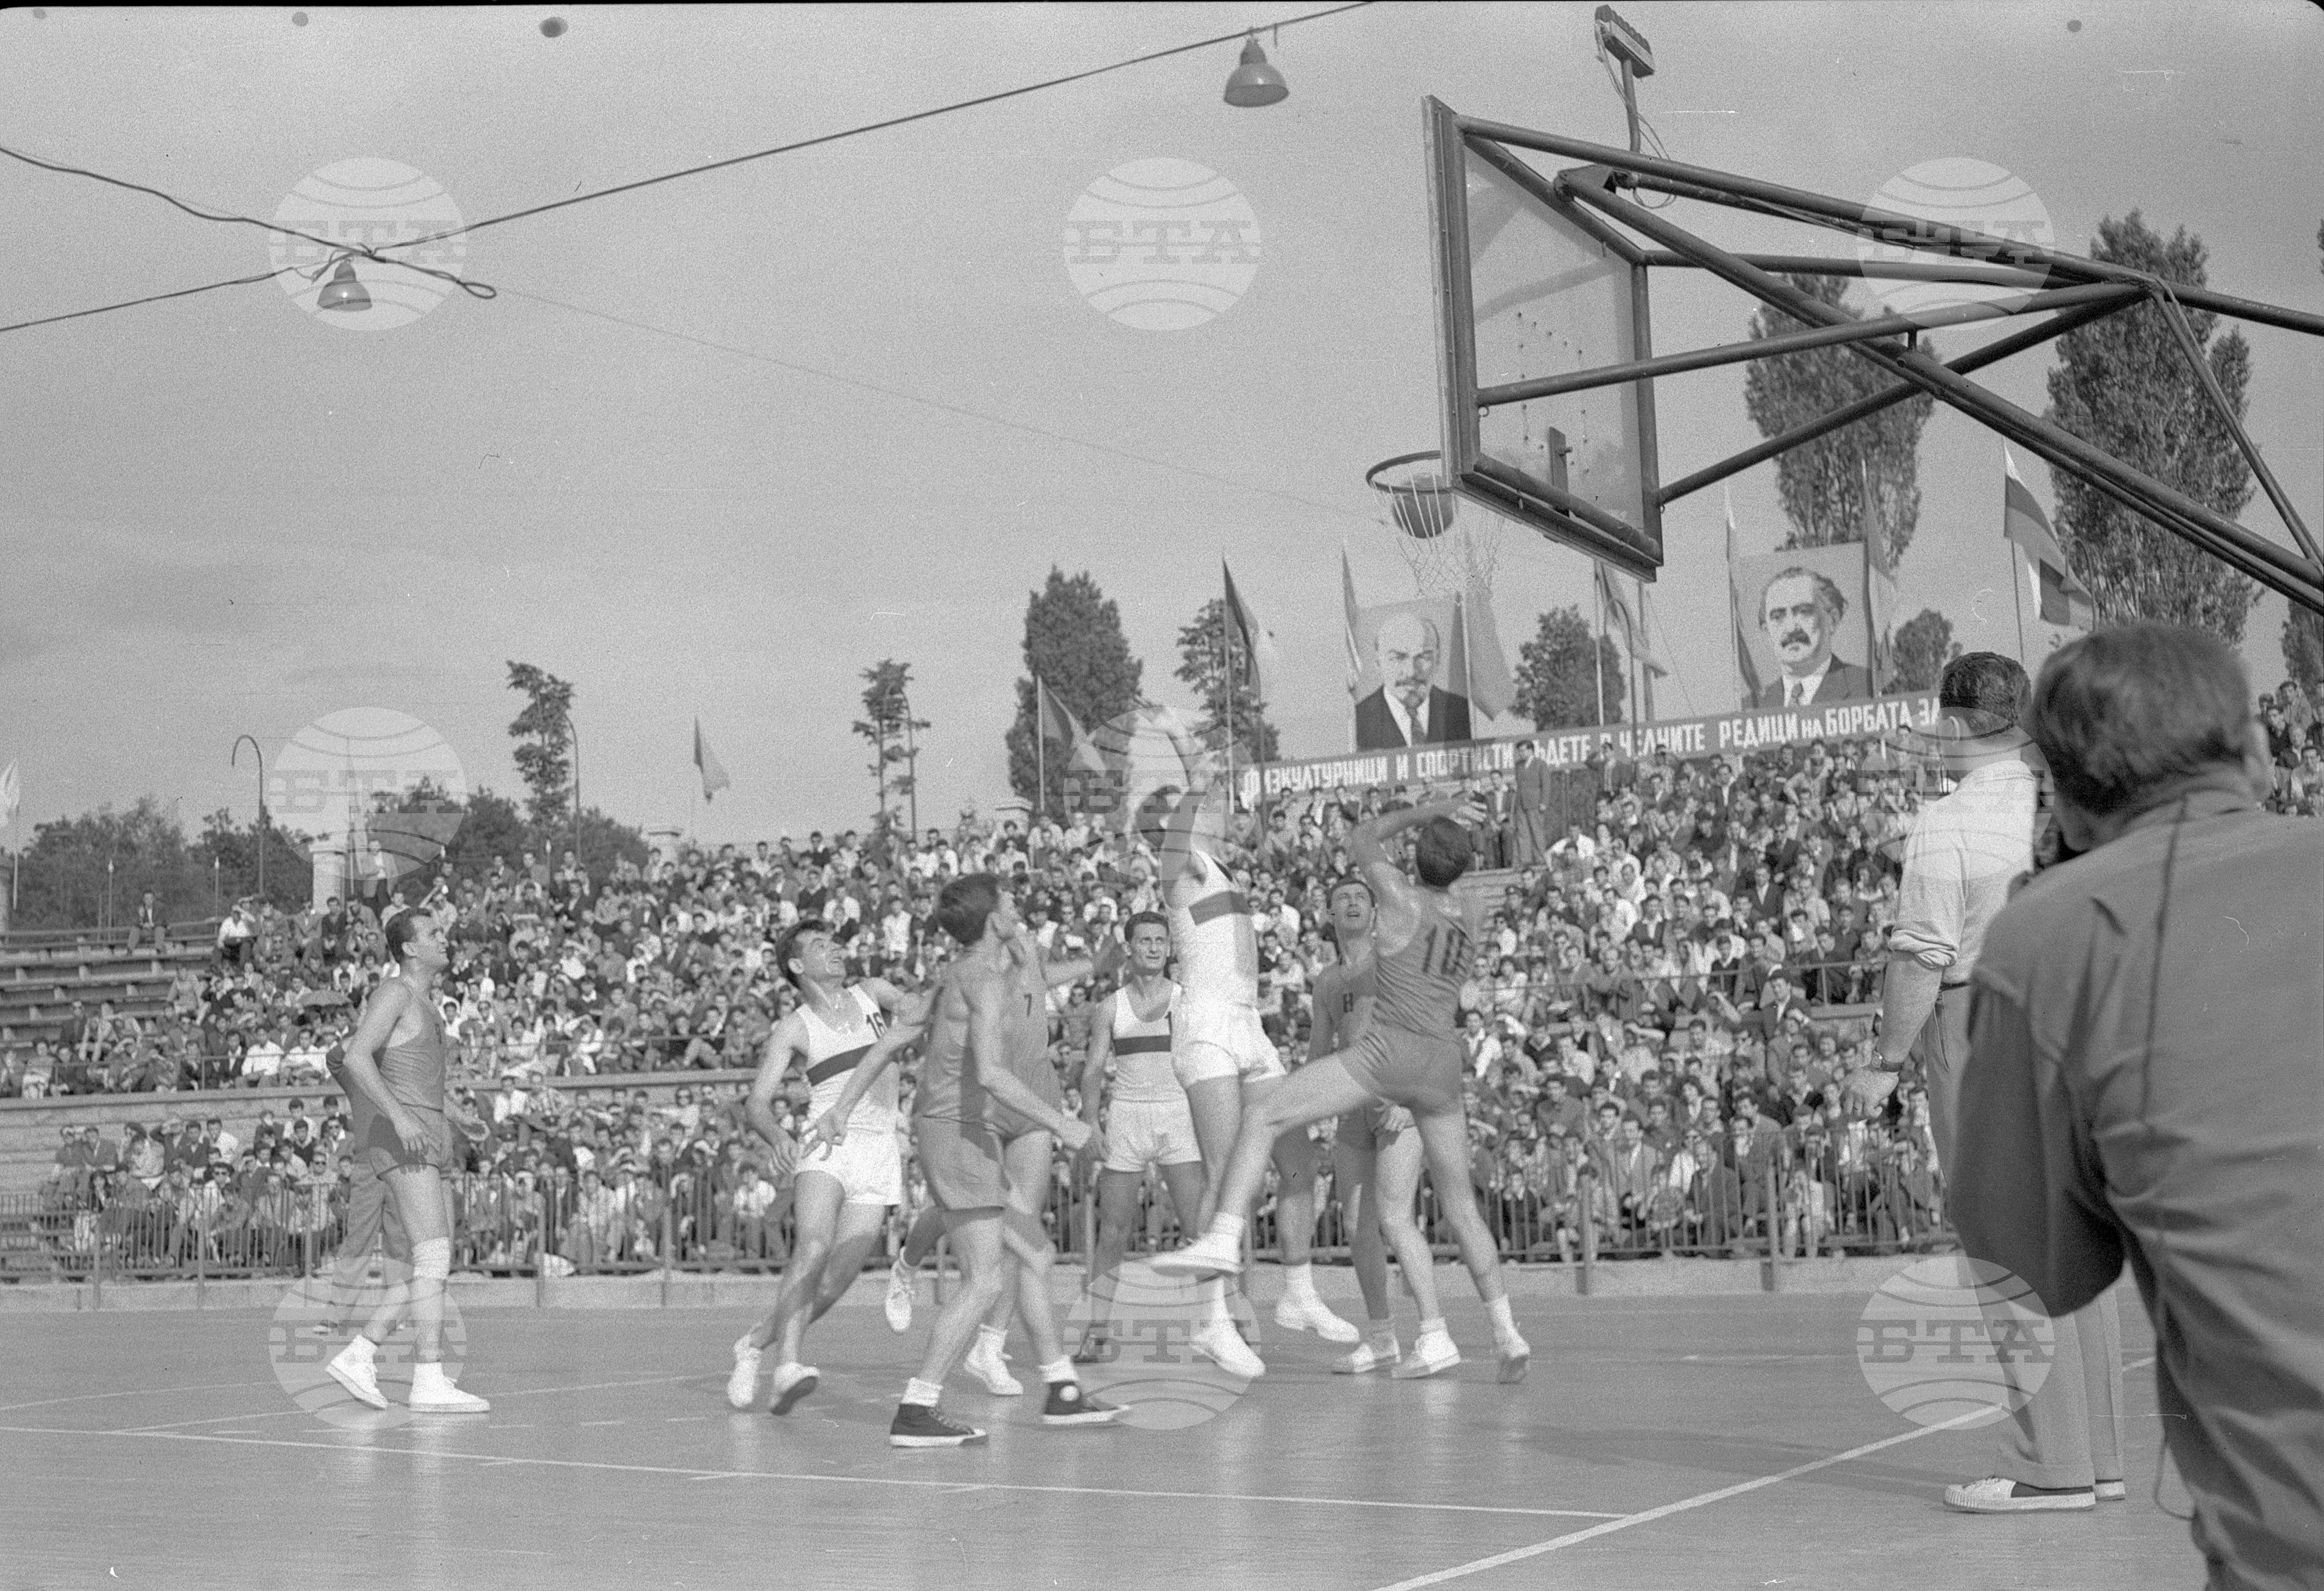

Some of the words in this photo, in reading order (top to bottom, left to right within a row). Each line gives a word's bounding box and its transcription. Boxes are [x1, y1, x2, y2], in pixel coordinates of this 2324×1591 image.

[1396, 754, 1409, 781] И
[1719, 712, 1799, 749] РЕДИЦИ
[1826, 700, 1913, 737] БОРБАТА
[1023, 993, 1032, 1017] 7
